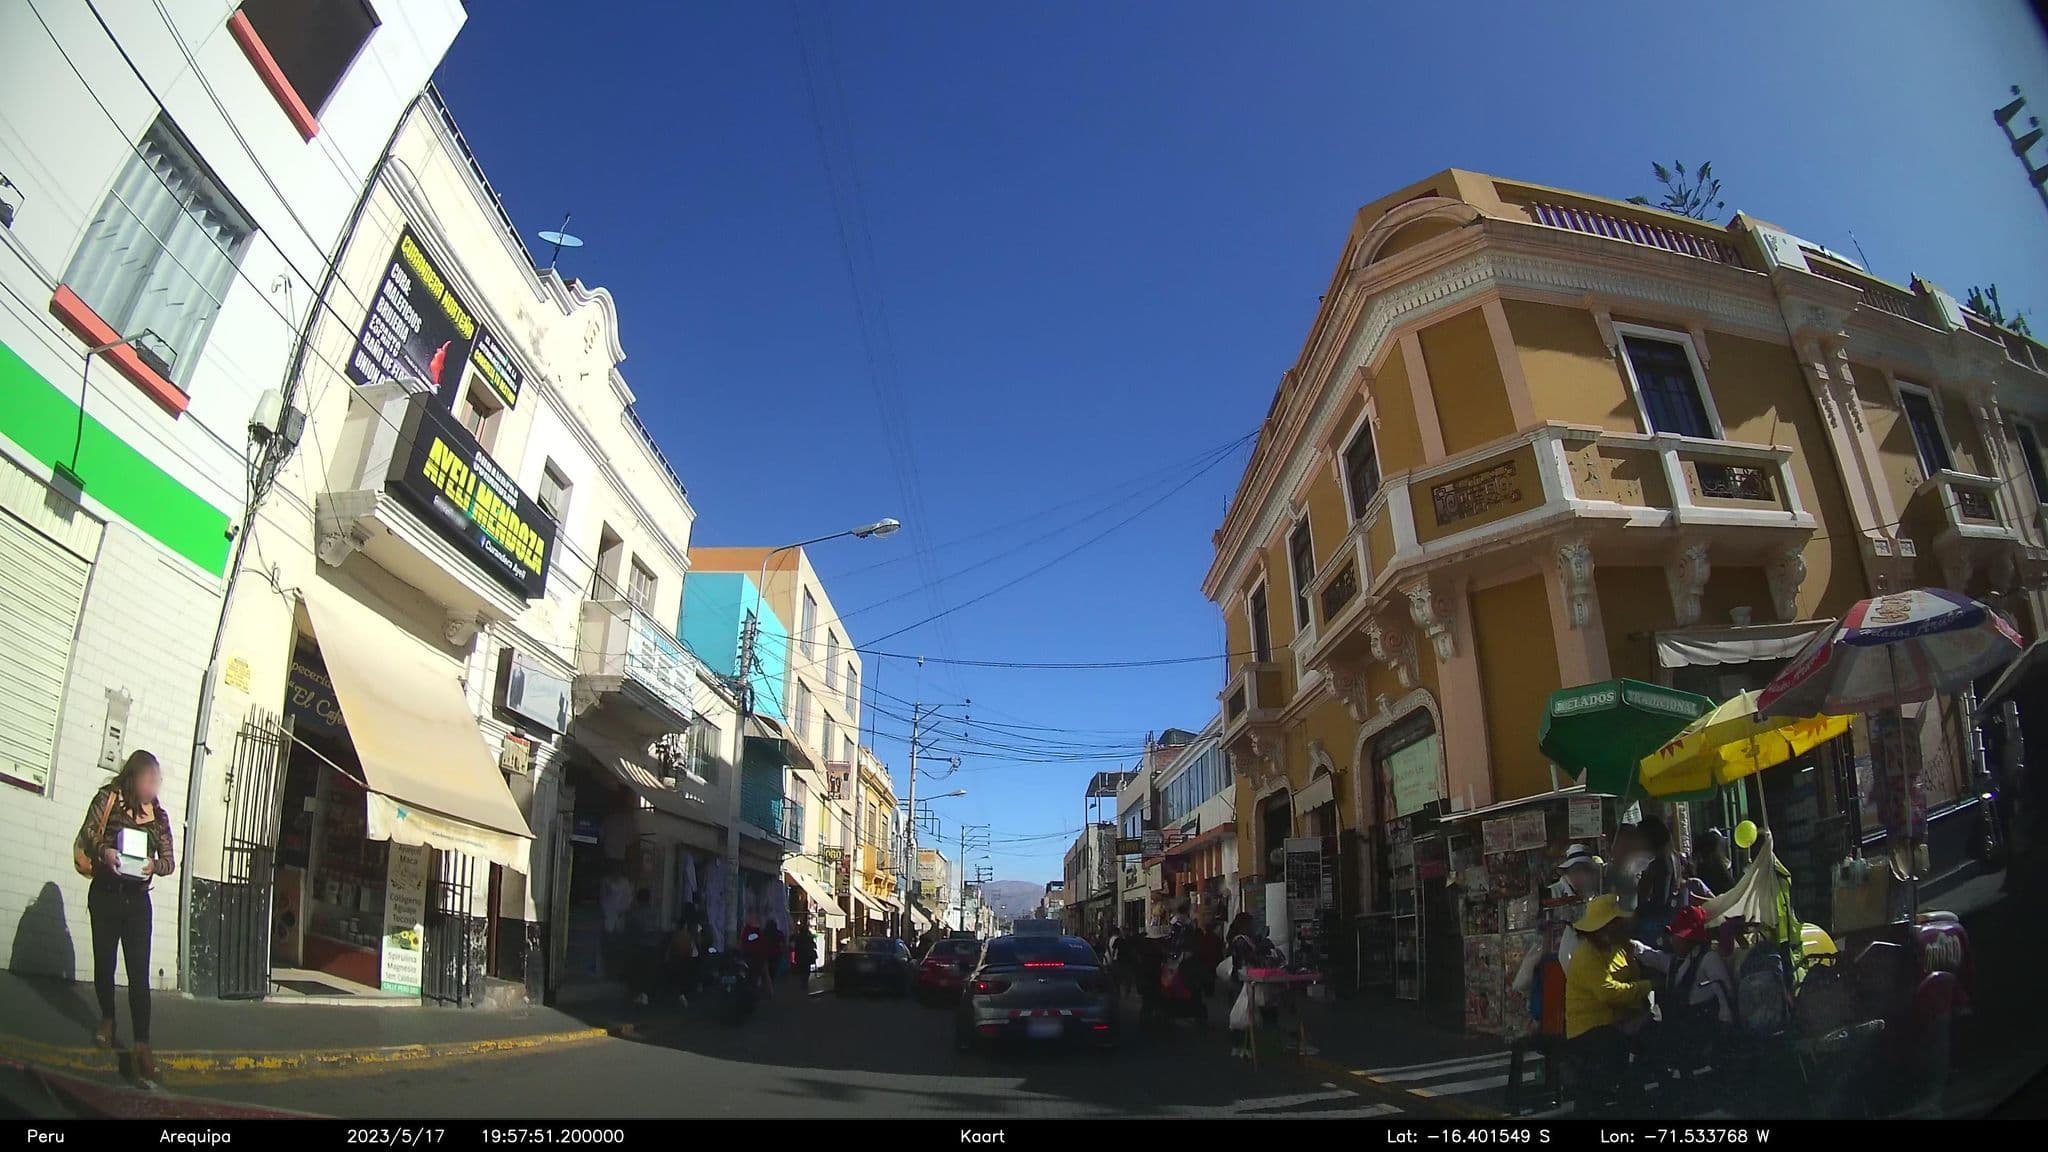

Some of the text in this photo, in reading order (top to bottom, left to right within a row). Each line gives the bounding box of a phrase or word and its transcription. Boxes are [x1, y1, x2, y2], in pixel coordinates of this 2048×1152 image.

[390, 262, 412, 297] CURA:
[401, 235, 445, 301] CURANDERA
[376, 296, 409, 344] BRUJERIA
[383, 279, 423, 334] MALEFICIOS
[471, 481, 545, 577] MENDOZA
[485, 537, 513, 569] Curandera
